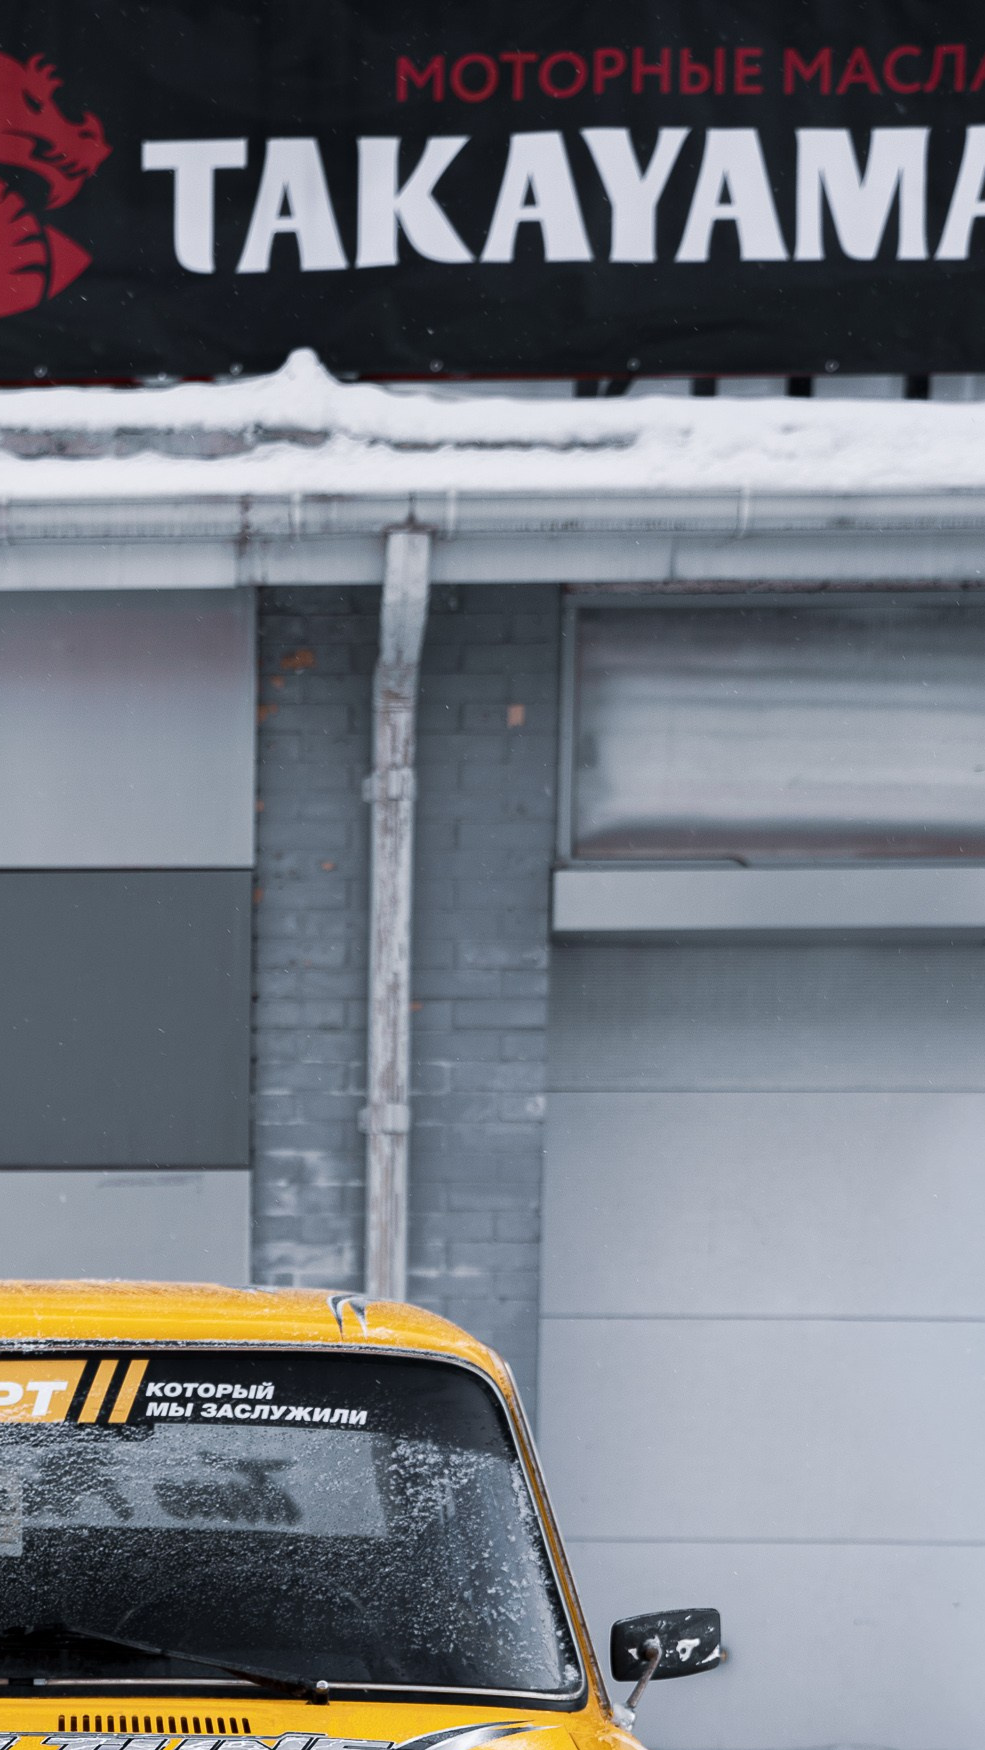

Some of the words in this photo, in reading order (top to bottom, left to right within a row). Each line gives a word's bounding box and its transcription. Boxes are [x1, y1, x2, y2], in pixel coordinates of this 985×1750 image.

[396, 47, 764, 103] МОТОРНЫЕ
[145, 1381, 275, 1400] КОТОРЫЙ
[146, 1402, 193, 1418] МЫ
[200, 1403, 368, 1426] ЗАСЛУЖИЛИ
